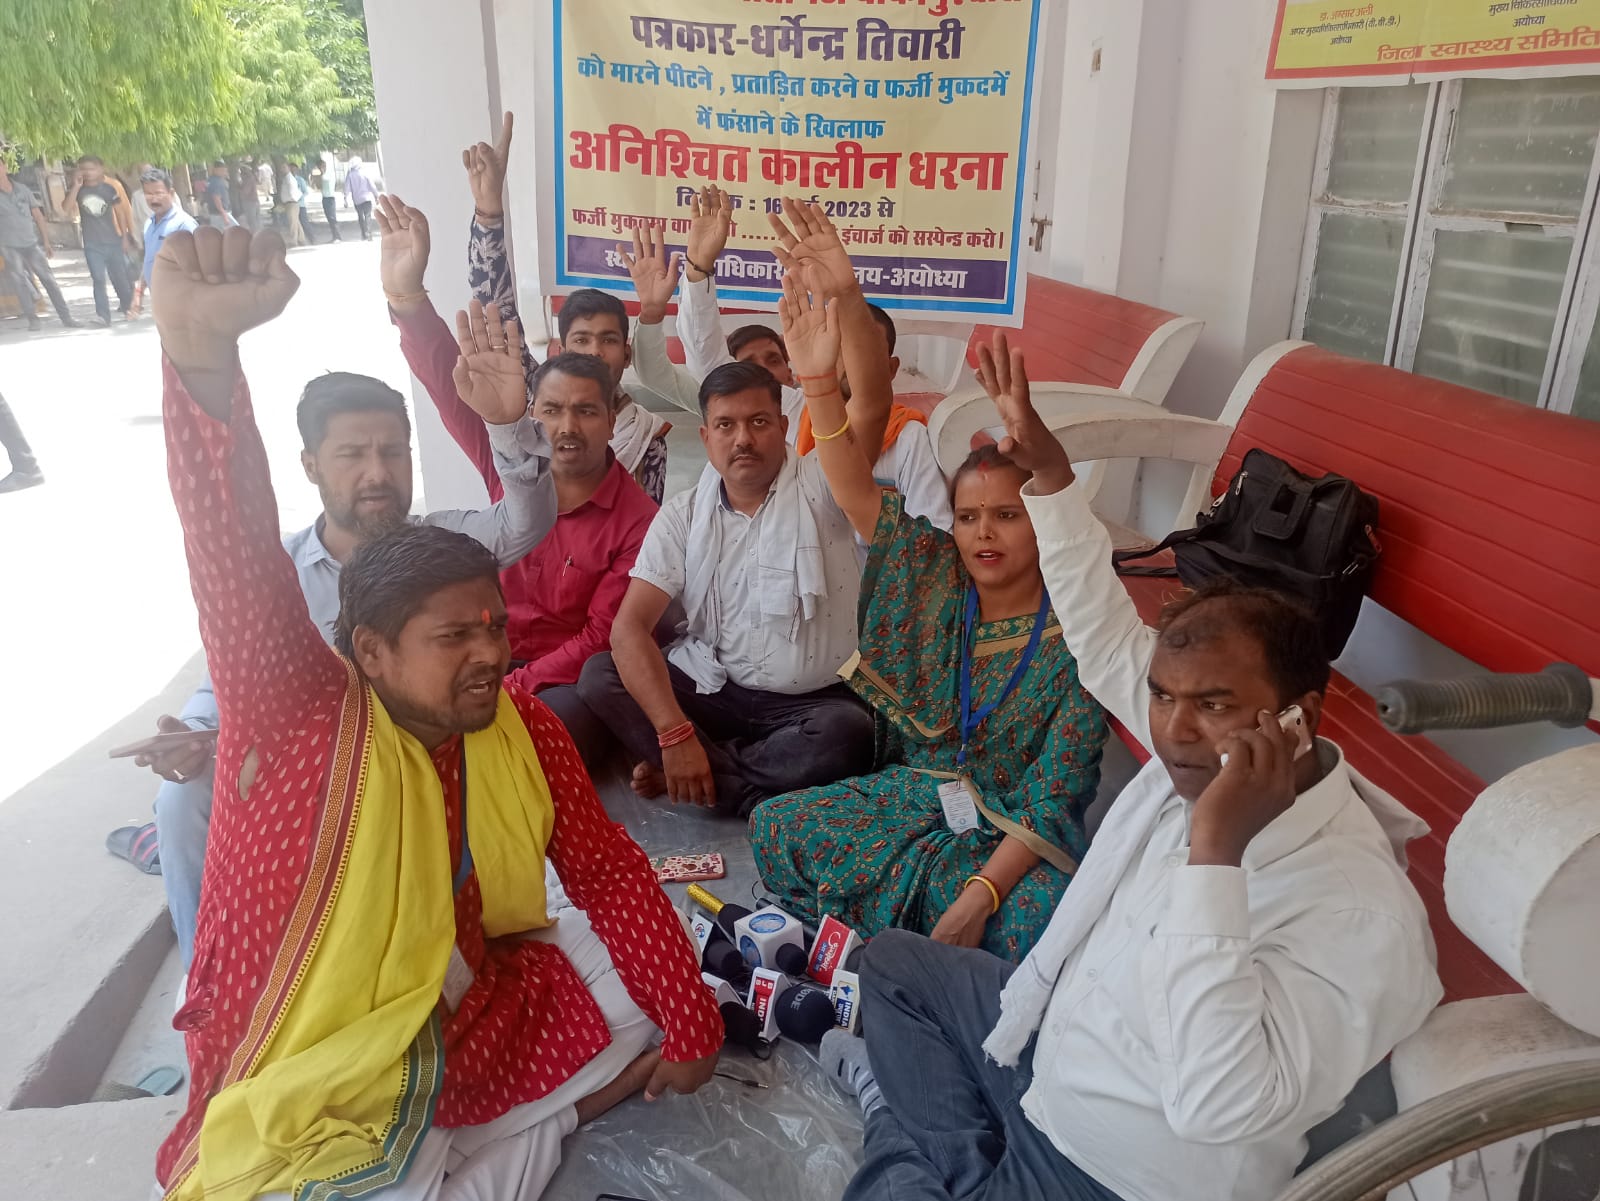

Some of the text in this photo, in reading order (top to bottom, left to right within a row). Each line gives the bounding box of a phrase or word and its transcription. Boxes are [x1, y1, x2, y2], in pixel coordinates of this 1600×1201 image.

[856, 17, 966, 62] तिवारी
[1513, 15, 1545, 27] अयोध्या
[1377, 25, 1600, 61] जिला स्वास्थ्य समिति
[577, 52, 605, 79] को
[610, 60, 660, 86] मारने
[732, 70, 806, 102] प्रताड़ित
[810, 72, 859, 99] करने
[864, 79, 880, 98] व
[885, 71, 933, 98] फर्जी
[938, 70, 1011, 104] मुकदमें
[696, 105, 887, 139] में फंसाने के खिलाफ
[569, 123, 1009, 191] अनिश्चित कालीन धरना
[763, 197, 784, 214] 16
[824, 200, 871, 217] 2023
[876, 196, 896, 218] से
[572, 207, 608, 227] फर्जी
[888, 225, 909, 245] को
